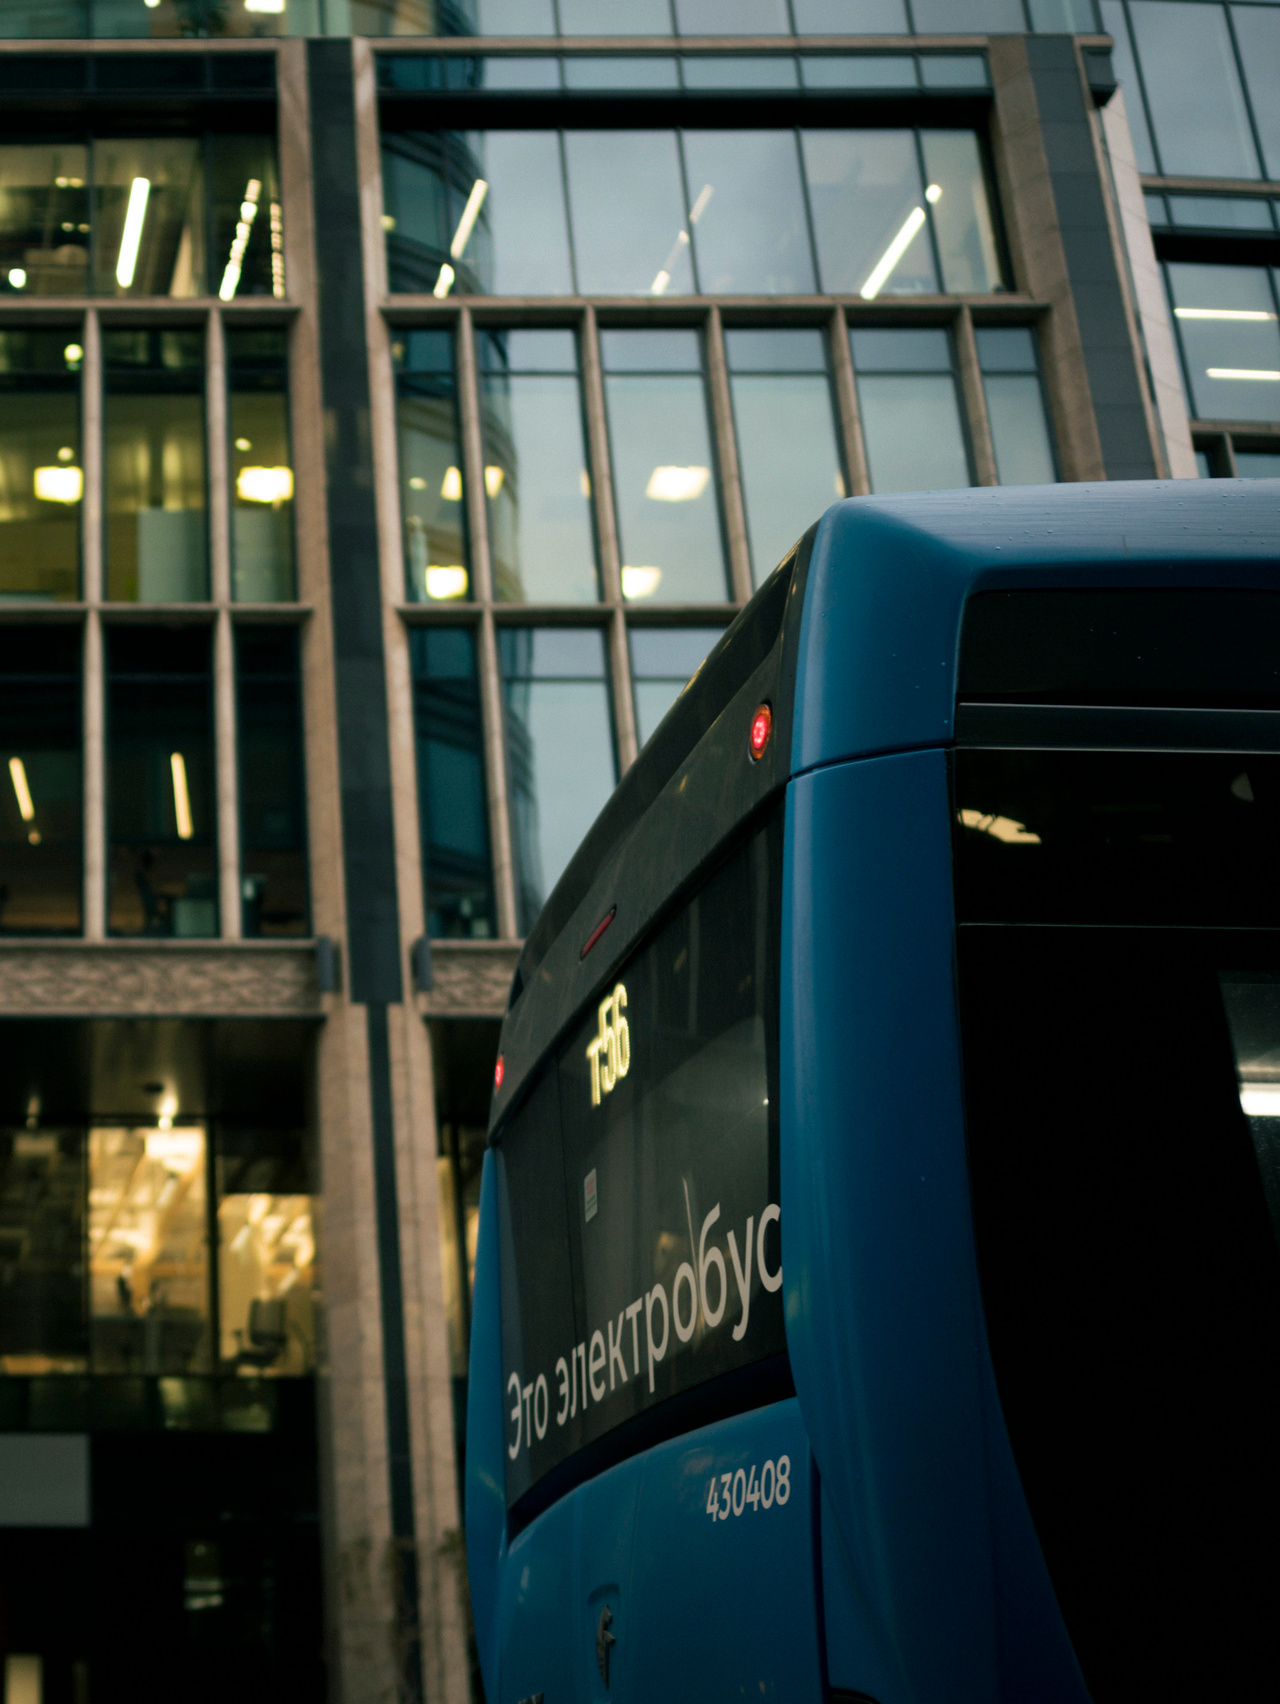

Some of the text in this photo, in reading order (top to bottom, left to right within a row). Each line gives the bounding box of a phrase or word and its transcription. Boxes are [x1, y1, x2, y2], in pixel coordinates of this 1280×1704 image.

[507, 1202, 784, 1460] Это электробус
[706, 1455, 791, 1523] 430408
